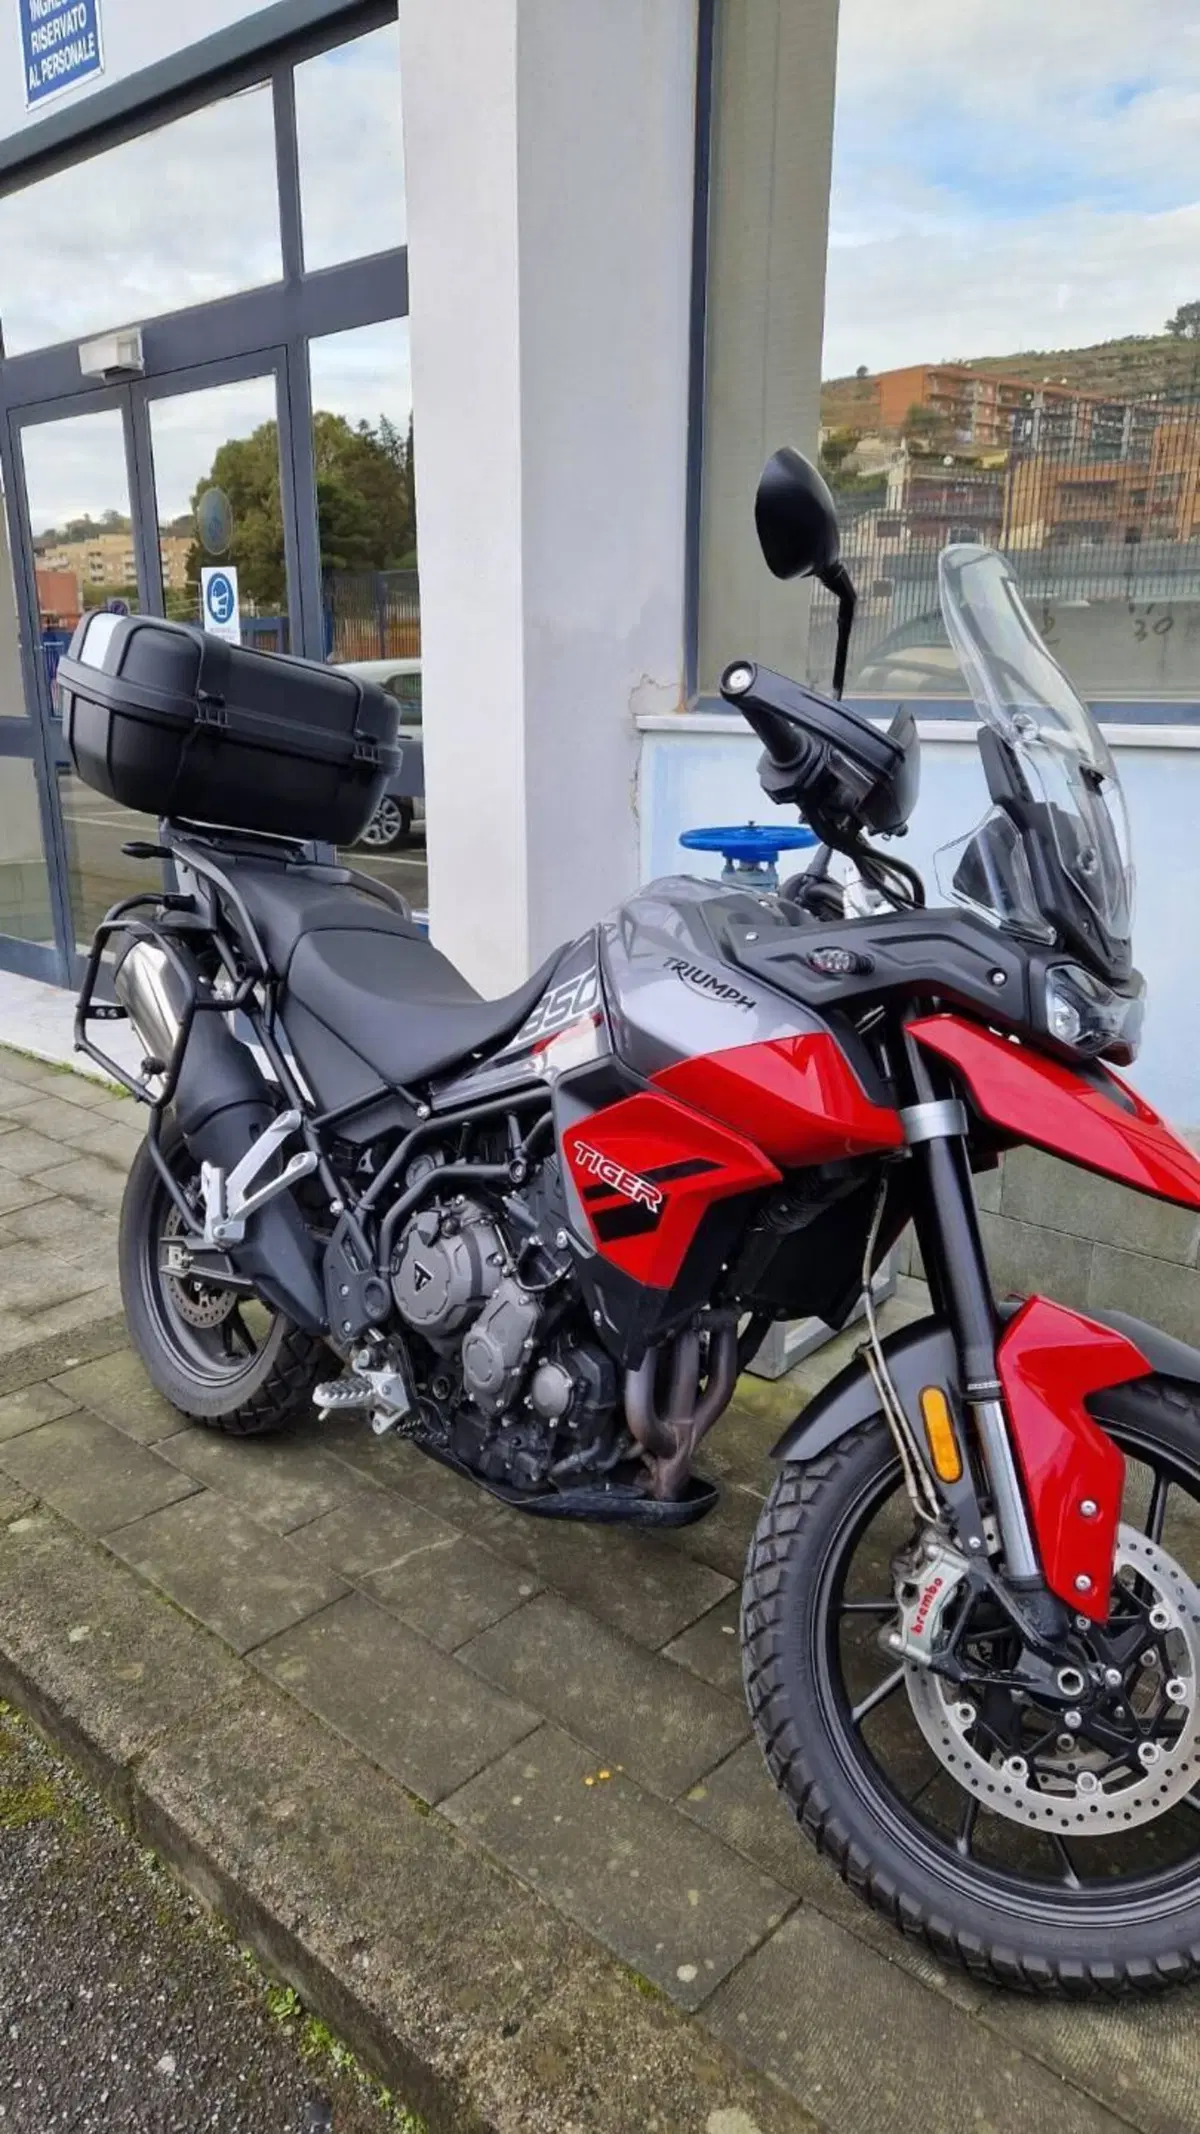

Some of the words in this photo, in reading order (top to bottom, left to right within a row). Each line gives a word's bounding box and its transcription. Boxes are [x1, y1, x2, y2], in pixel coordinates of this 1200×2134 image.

[31, 3, 87, 55] RISERVATO
[28, 64, 41, 90] AL
[41, 32, 95, 82] PERSONALE
[663, 956, 757, 1014] TRIUMPH
[573, 1140, 663, 1213] TIGER
[910, 1577, 944, 1637] brembo
